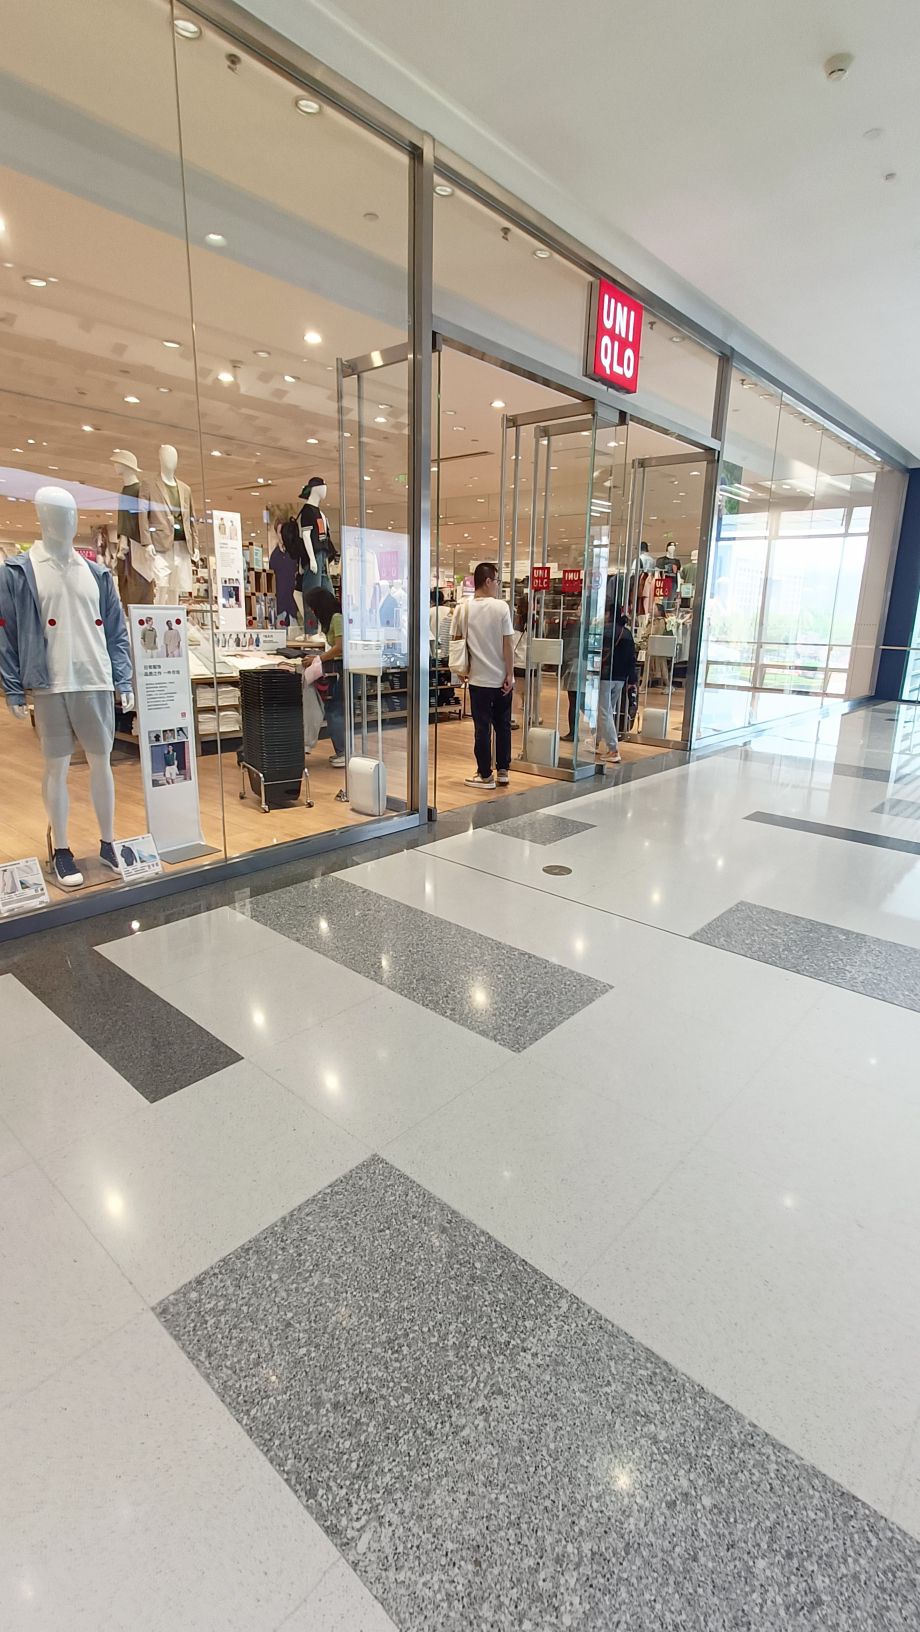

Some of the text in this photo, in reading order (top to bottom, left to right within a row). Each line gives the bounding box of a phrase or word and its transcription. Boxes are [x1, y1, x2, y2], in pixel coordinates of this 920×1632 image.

[603, 293, 635, 343] UNI
[600, 335, 635, 379] QLO
[533, 569, 548, 578] UNI
